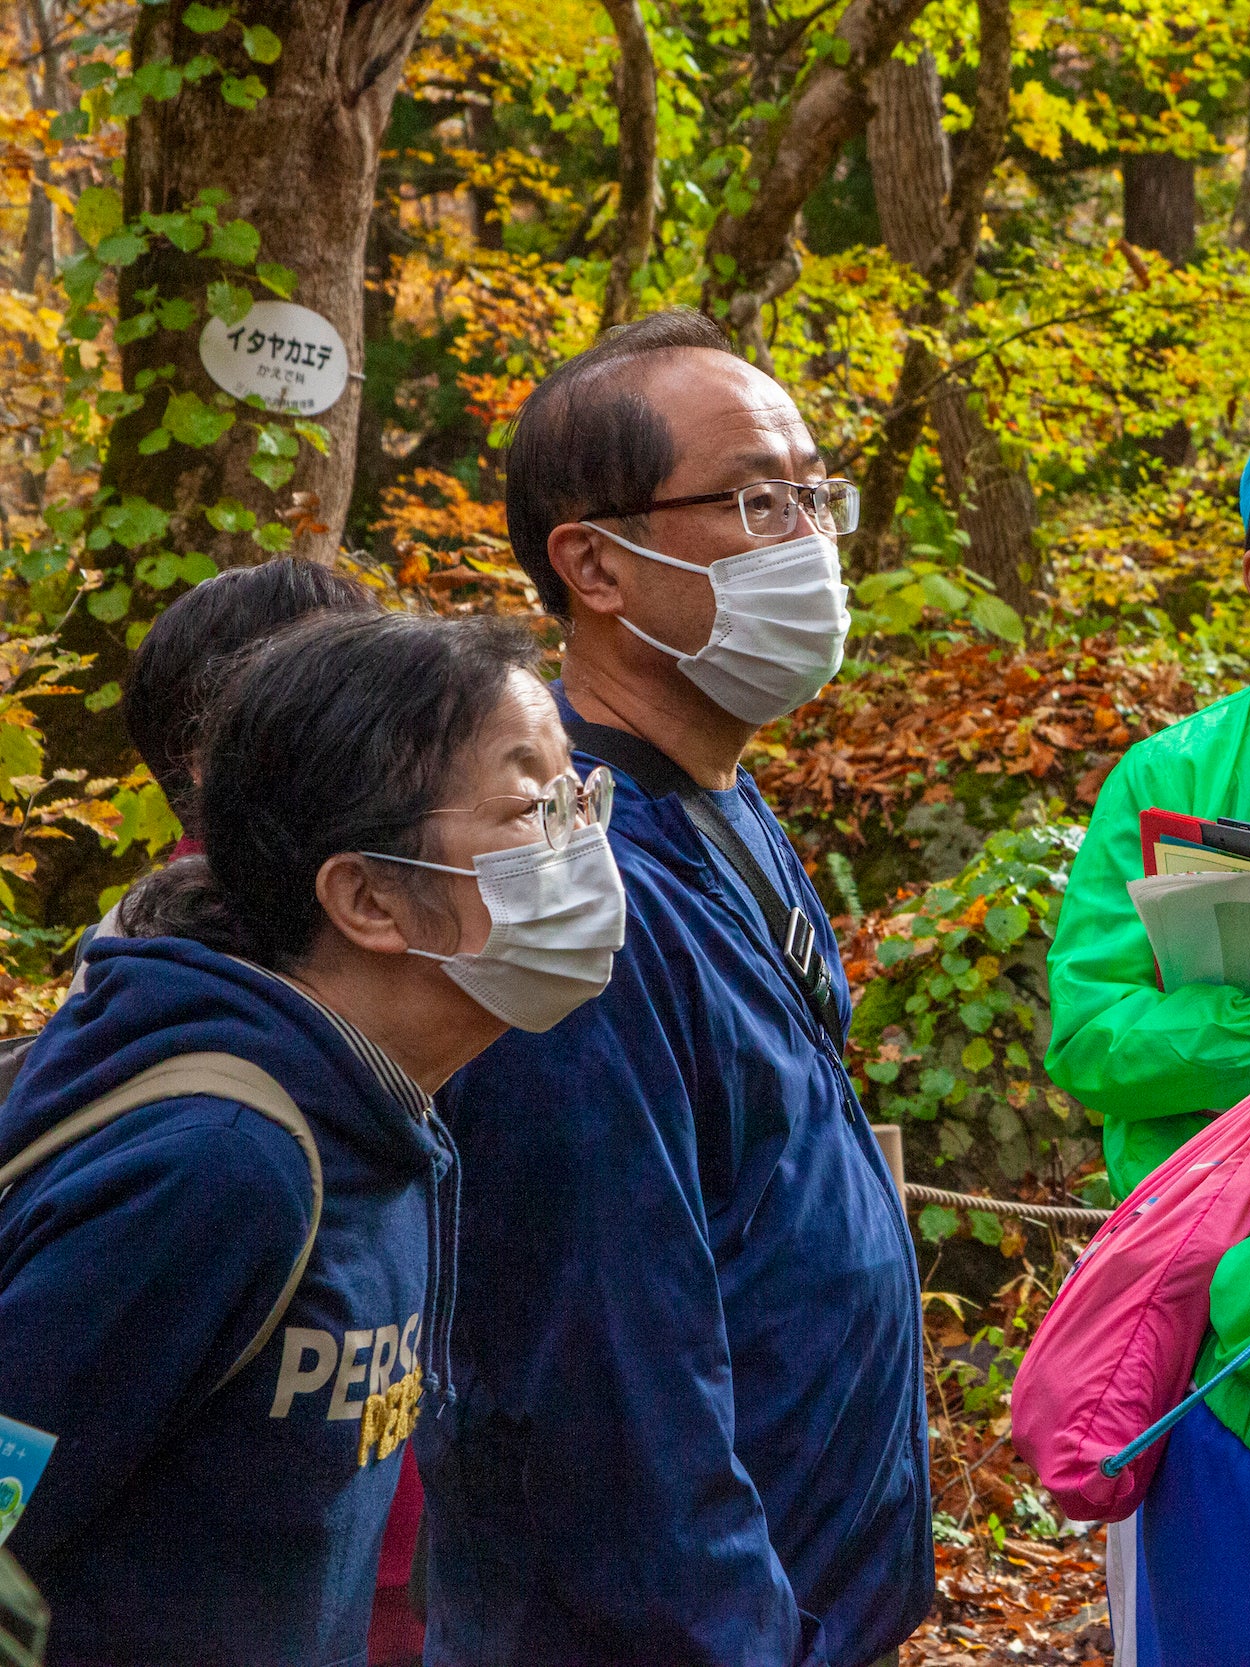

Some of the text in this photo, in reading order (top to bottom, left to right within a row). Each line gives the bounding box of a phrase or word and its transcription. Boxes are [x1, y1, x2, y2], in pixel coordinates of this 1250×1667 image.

[227, 326, 333, 370] イタヤカエデ
